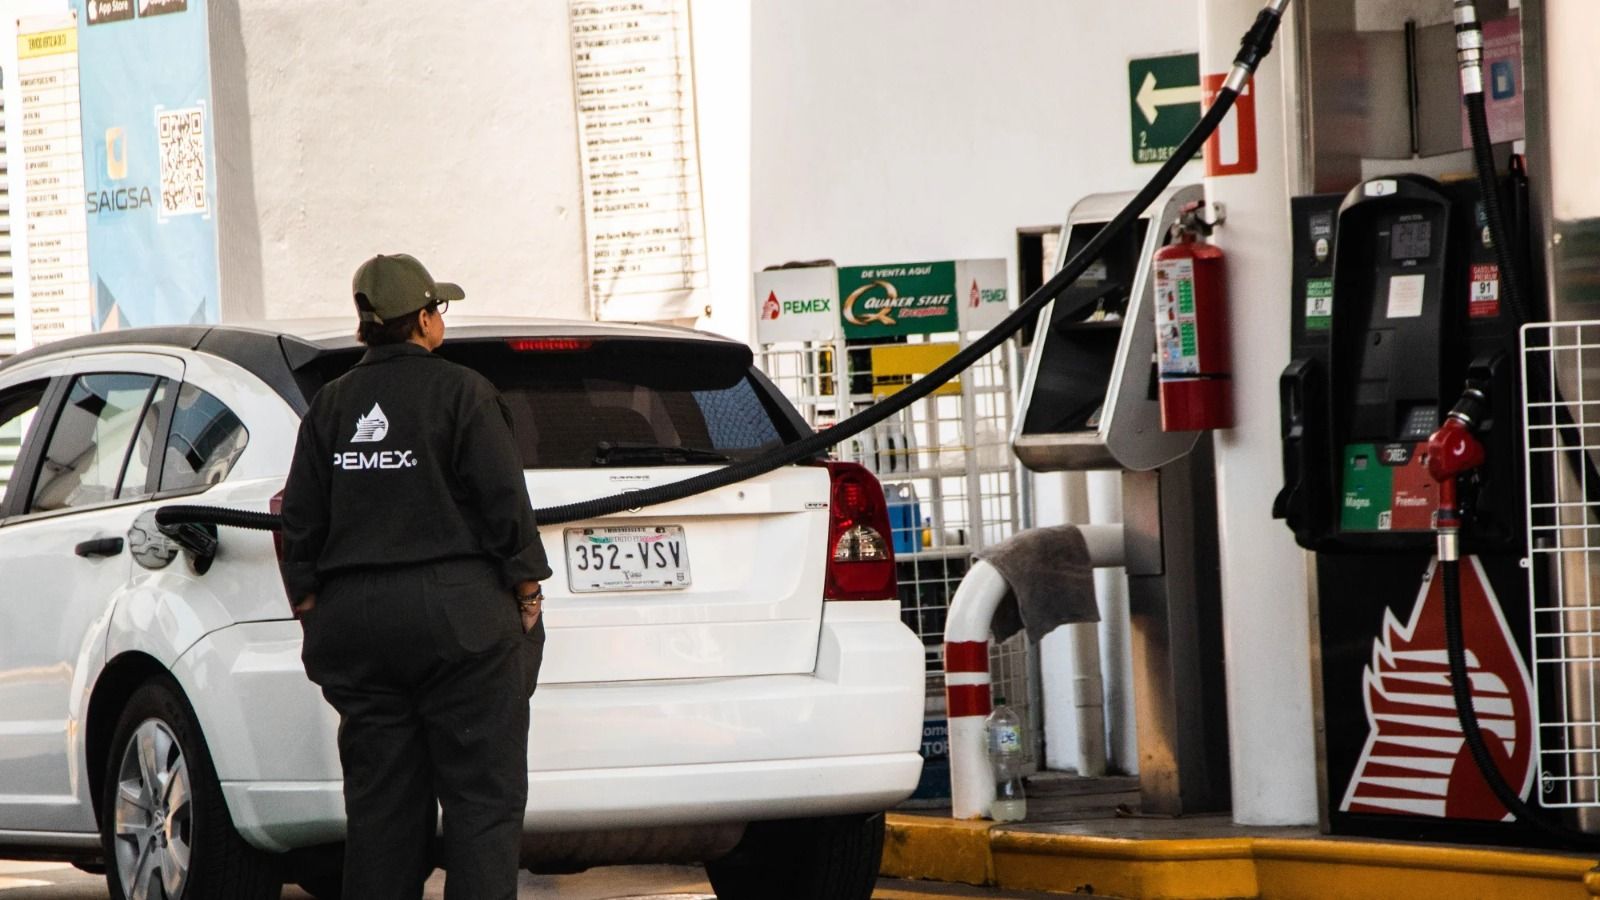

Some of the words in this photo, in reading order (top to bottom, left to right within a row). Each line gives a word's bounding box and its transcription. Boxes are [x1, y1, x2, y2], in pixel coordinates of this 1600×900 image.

[98, 2, 112, 16] App
[112, 0, 129, 12] Store
[1140, 131, 1148, 148] 2
[1138, 148, 1157, 162] RUTA
[1158, 147, 1169, 161] DE
[87, 186, 153, 214] SAIGSA
[861, 269, 873, 279] DE
[876, 267, 906, 279] VENTA
[908, 265, 933, 277] AQUÍ
[1479, 282, 1491, 294] 91
[783, 298, 831, 314] PEMEX
[864, 296, 914, 310] QUAKER
[916, 294, 953, 306] STATE
[333, 450, 412, 470] PEMEX
[1345, 496, 1371, 510] Magna
[1395, 495, 1428, 507] Premium
[576, 541, 679, 570] 352-VSV
